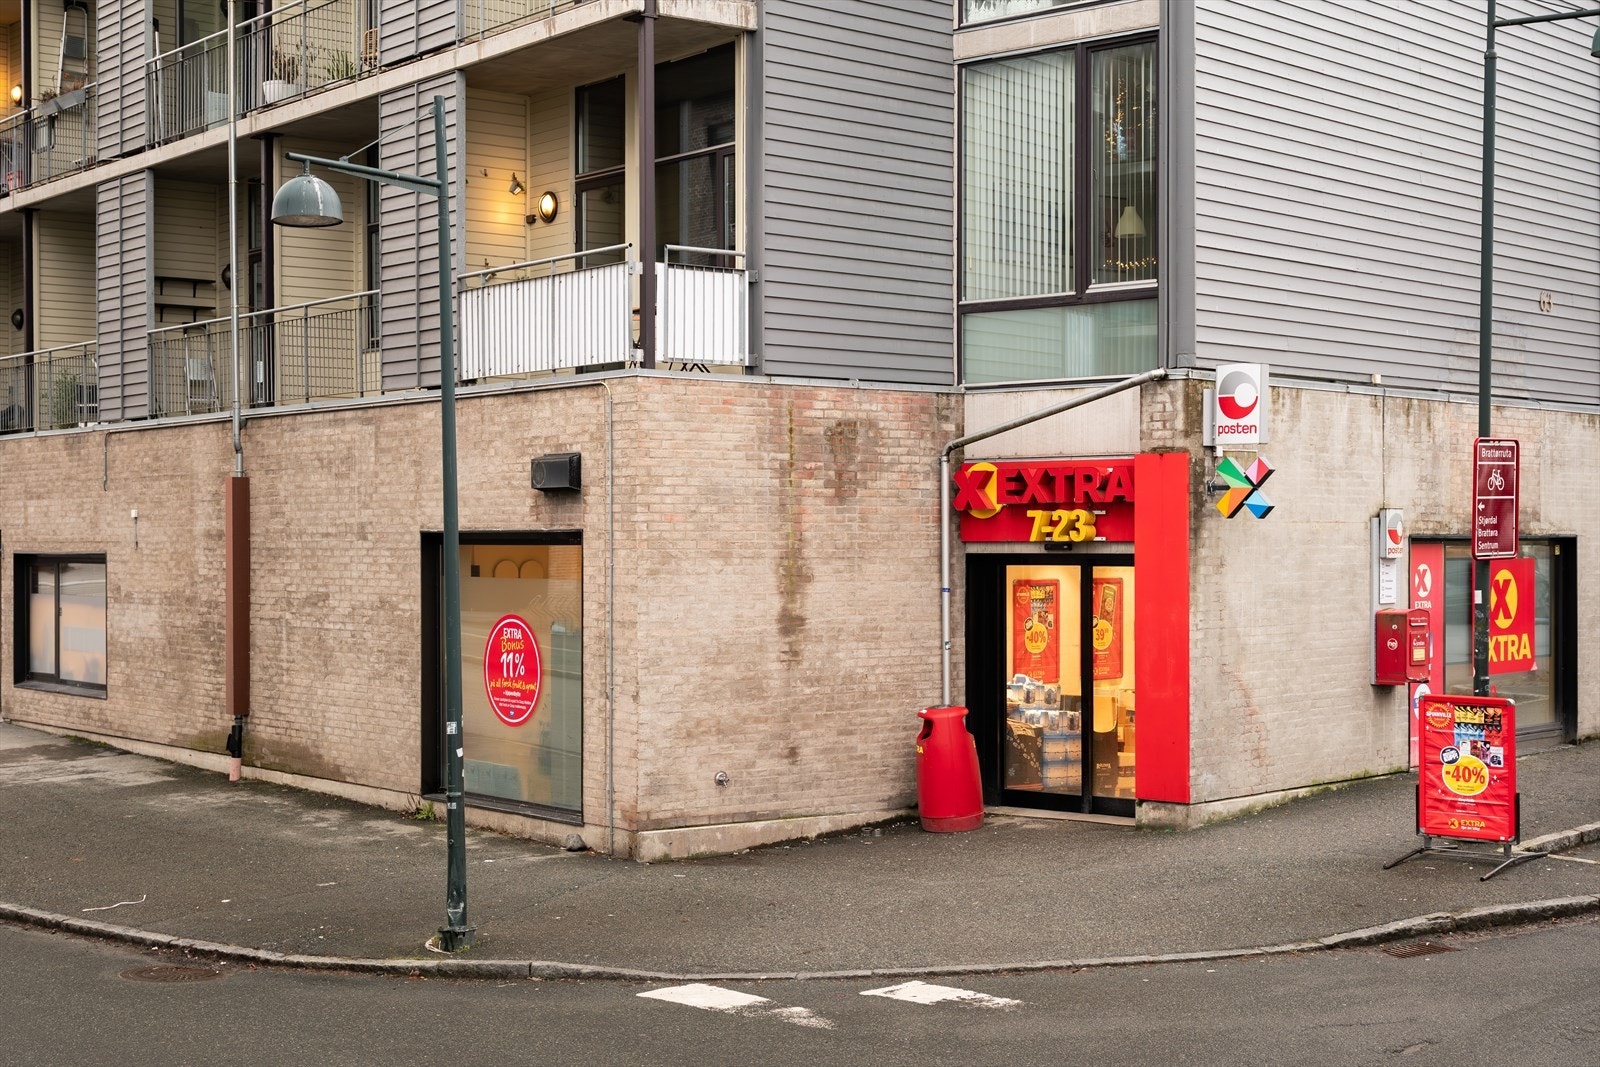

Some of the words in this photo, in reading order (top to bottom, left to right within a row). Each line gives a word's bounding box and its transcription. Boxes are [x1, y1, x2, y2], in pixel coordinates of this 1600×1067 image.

[1539, 290, 1552, 312] 63
[1217, 422, 1258, 437] posten
[997, 466, 1135, 504] EXTRA
[1026, 508, 1096, 542] 7-23
[1478, 541, 1499, 550] Sentrum
[1414, 600, 1432, 609] EXTRA
[503, 628, 522, 640] EXTRA
[500, 636, 525, 653] Bonus
[1488, 632, 1532, 663] XTRA
[500, 651, 525, 678] 11%
[1445, 765, 1486, 785] -40%
[1460, 819, 1486, 828] EXTRA
